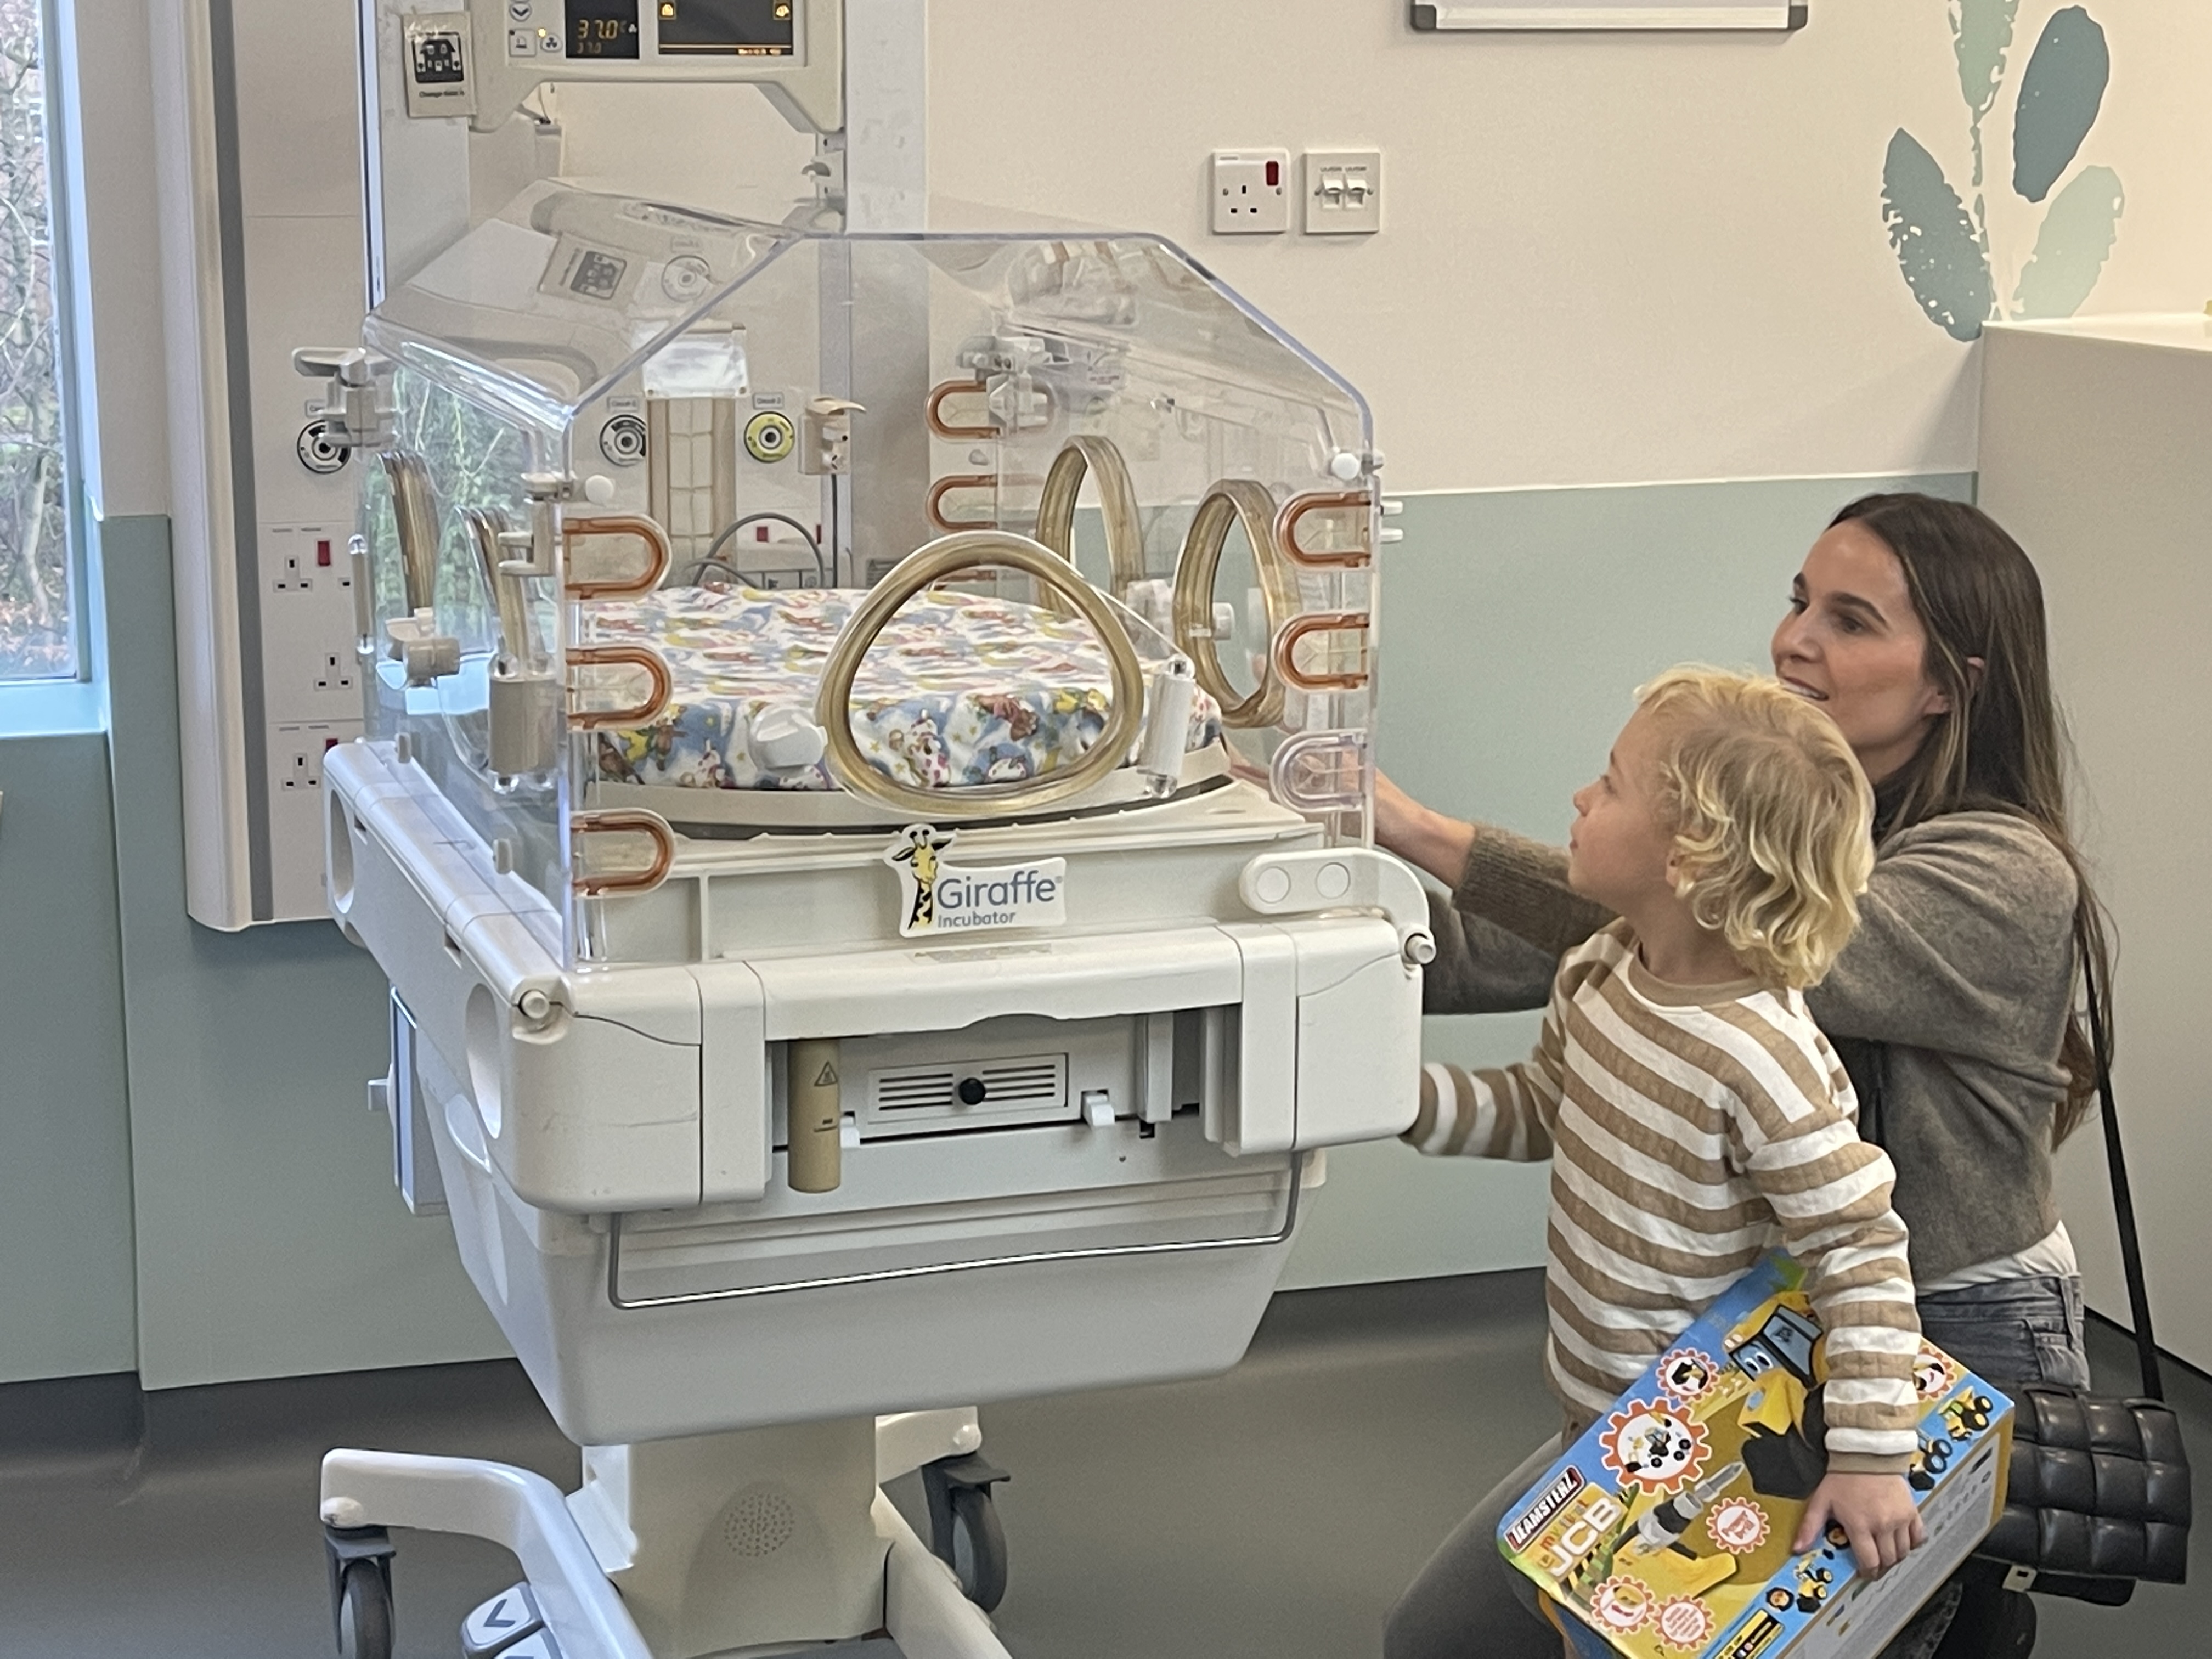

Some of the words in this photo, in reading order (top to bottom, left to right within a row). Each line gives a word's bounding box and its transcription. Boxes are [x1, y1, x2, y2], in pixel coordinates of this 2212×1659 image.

[936, 870, 1056, 909] Giraffe
[938, 911, 1015, 928] Incubator
[1550, 1497, 1623, 1577] JCB
